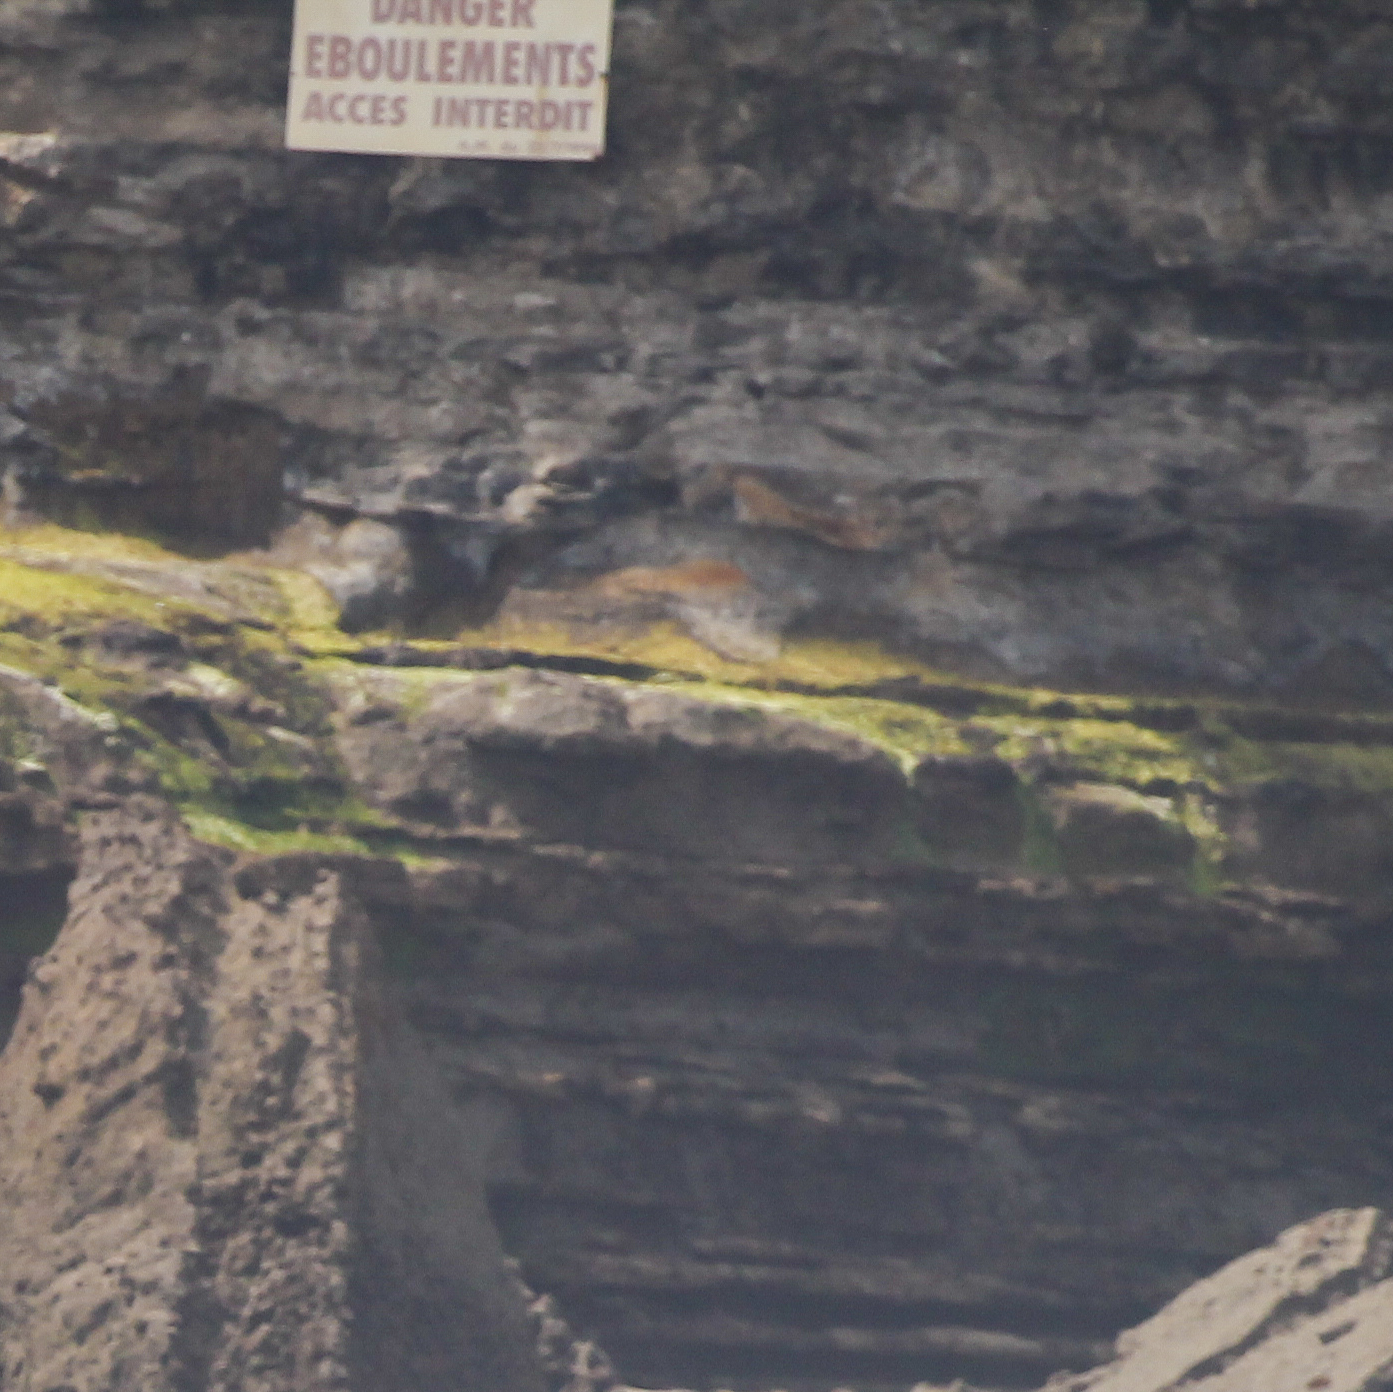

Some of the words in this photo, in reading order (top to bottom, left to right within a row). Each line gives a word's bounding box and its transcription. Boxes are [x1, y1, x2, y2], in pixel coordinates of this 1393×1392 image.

[370, 0, 535, 28] DANGER
[304, 35, 596, 88] EBOULEMENTS
[302, 91, 407, 127] ACCES
[430, 96, 593, 132] INTERDIT
